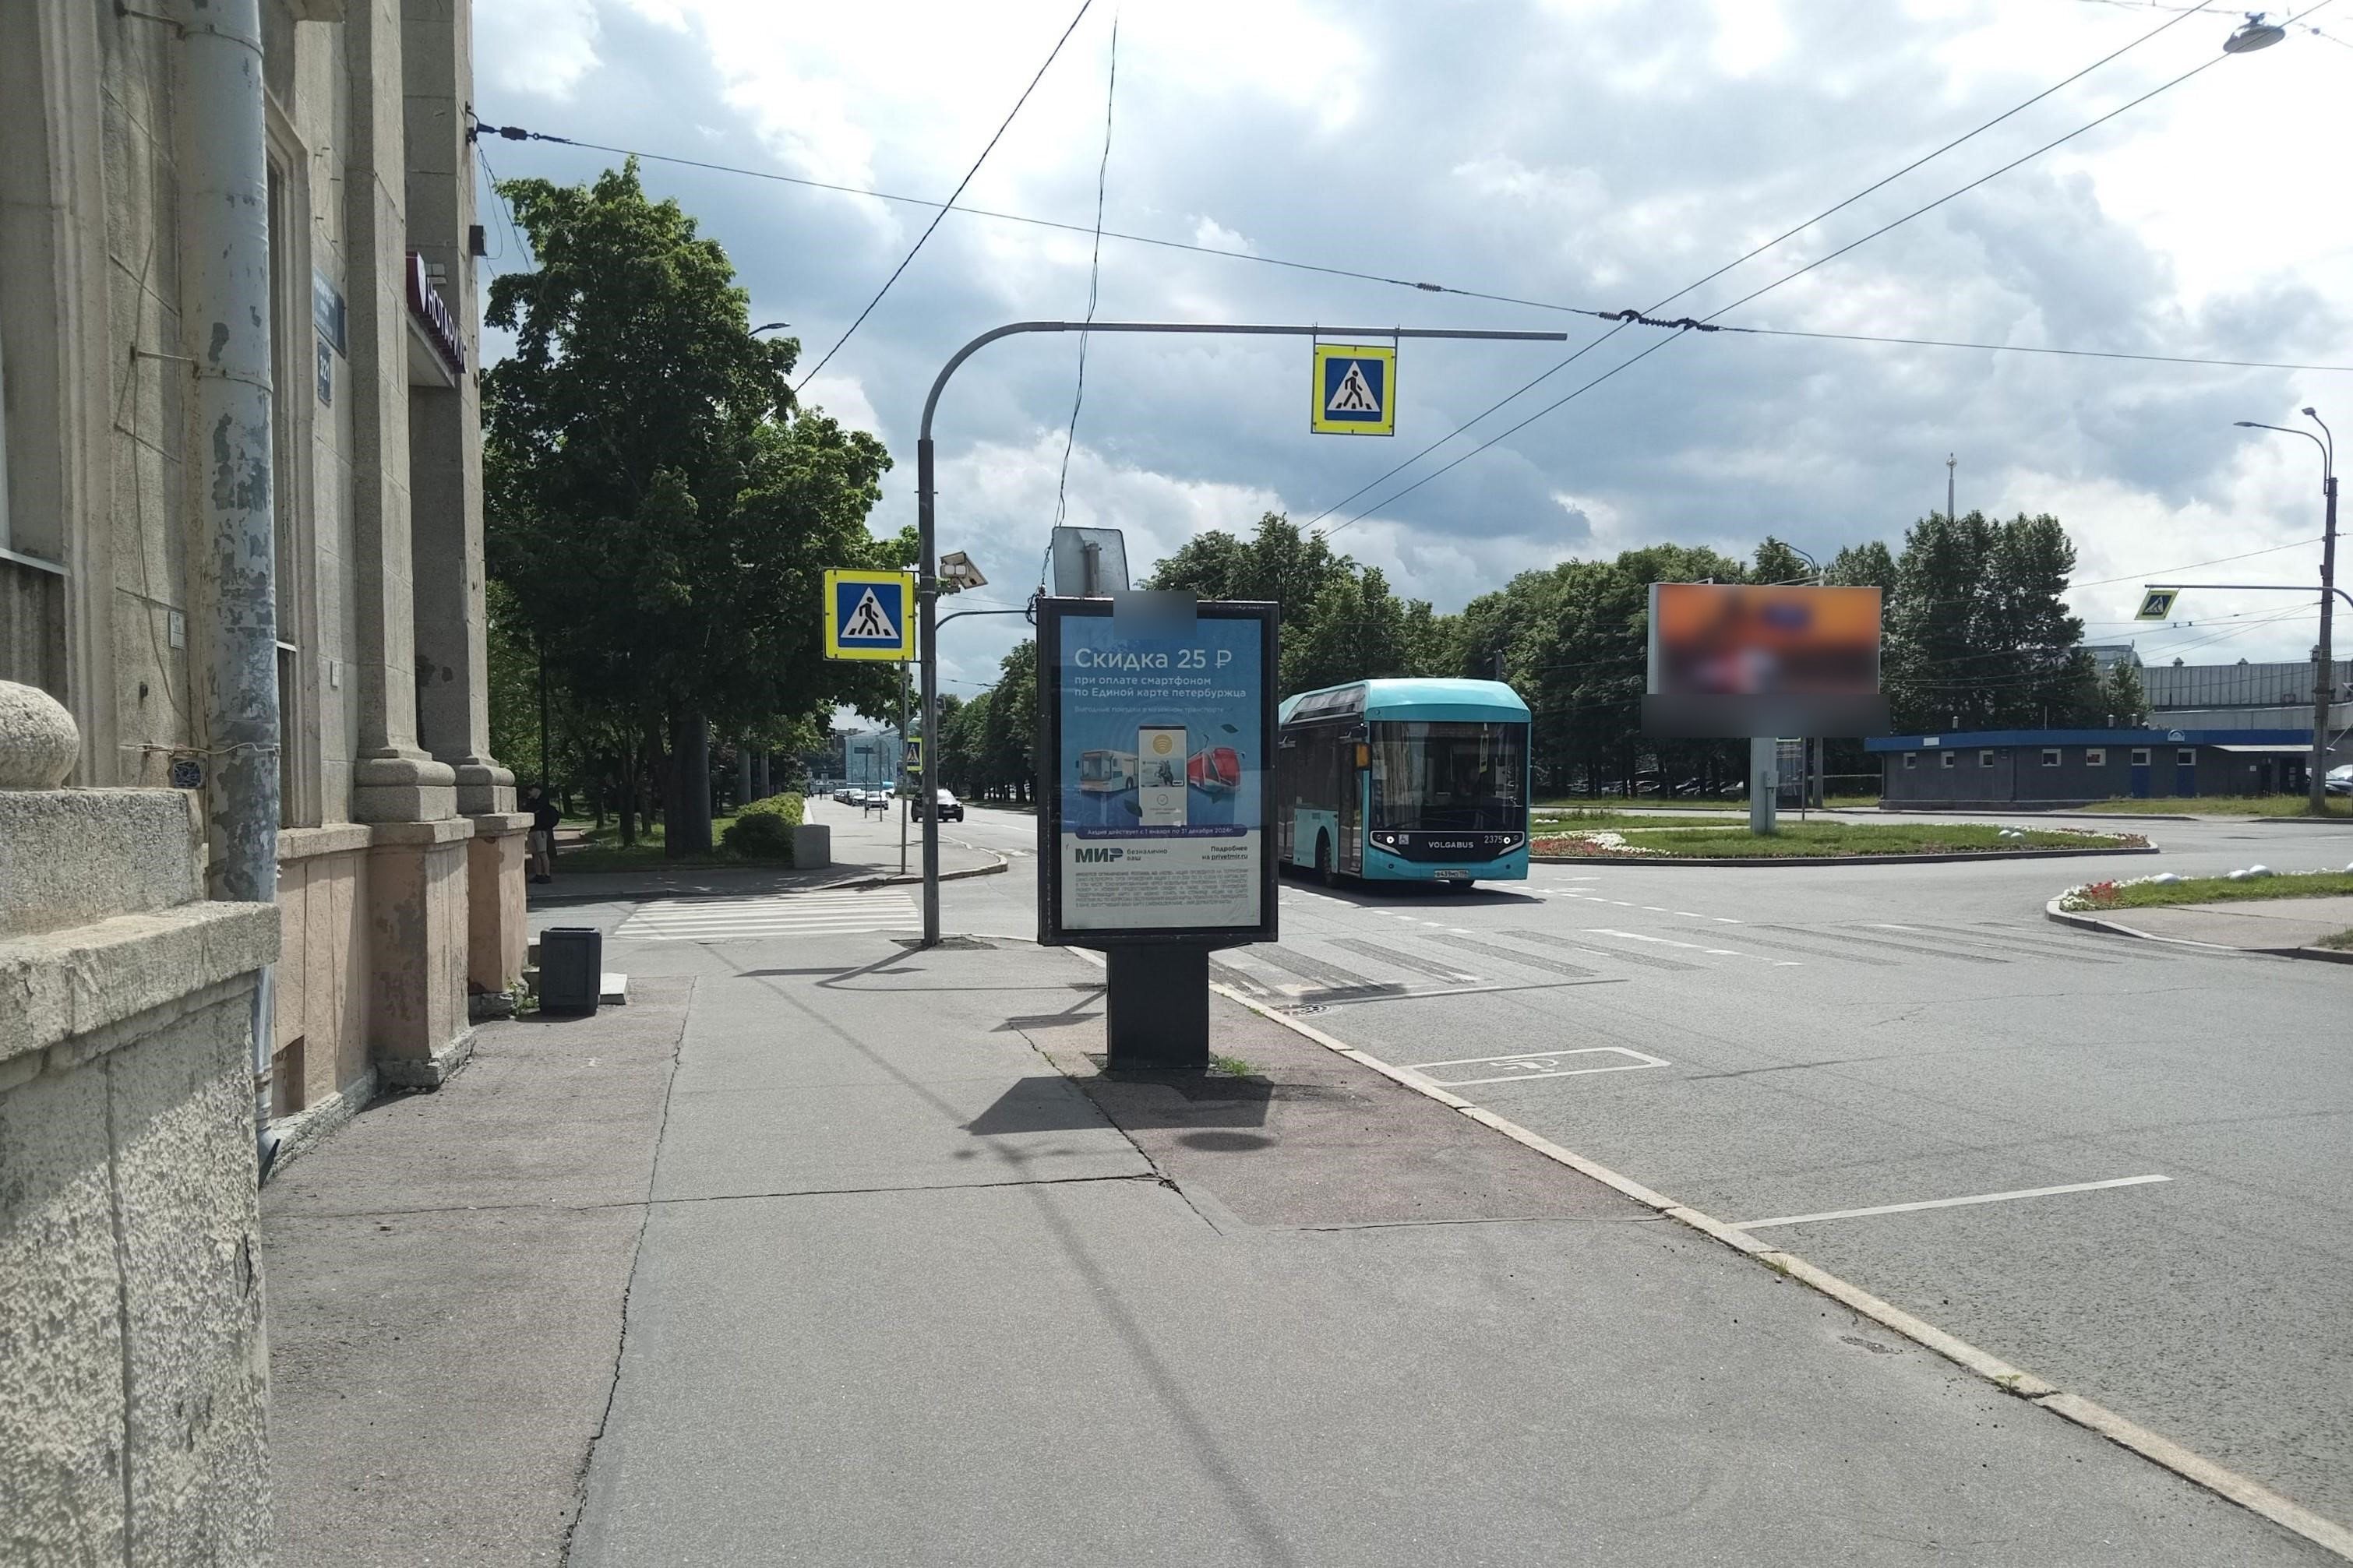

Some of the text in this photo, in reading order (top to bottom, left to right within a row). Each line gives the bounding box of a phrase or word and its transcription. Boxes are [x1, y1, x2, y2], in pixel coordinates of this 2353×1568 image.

[426, 277, 469, 374] НОТАРИУС
[1074, 648, 1169, 671] Скидка
[1177, 650, 1206, 668] 25
[1074, 676, 1095, 687] при
[1141, 675, 1211, 687] смартфоном
[1092, 687, 1134, 697] Единой
[1137, 689, 1169, 699] карте
[1172, 689, 1247, 699] петербуржца
[1484, 835, 1503, 844] 2375
[1075, 847, 1124, 863] МИР
[1212, 853, 1248, 862] privetmir.ru
